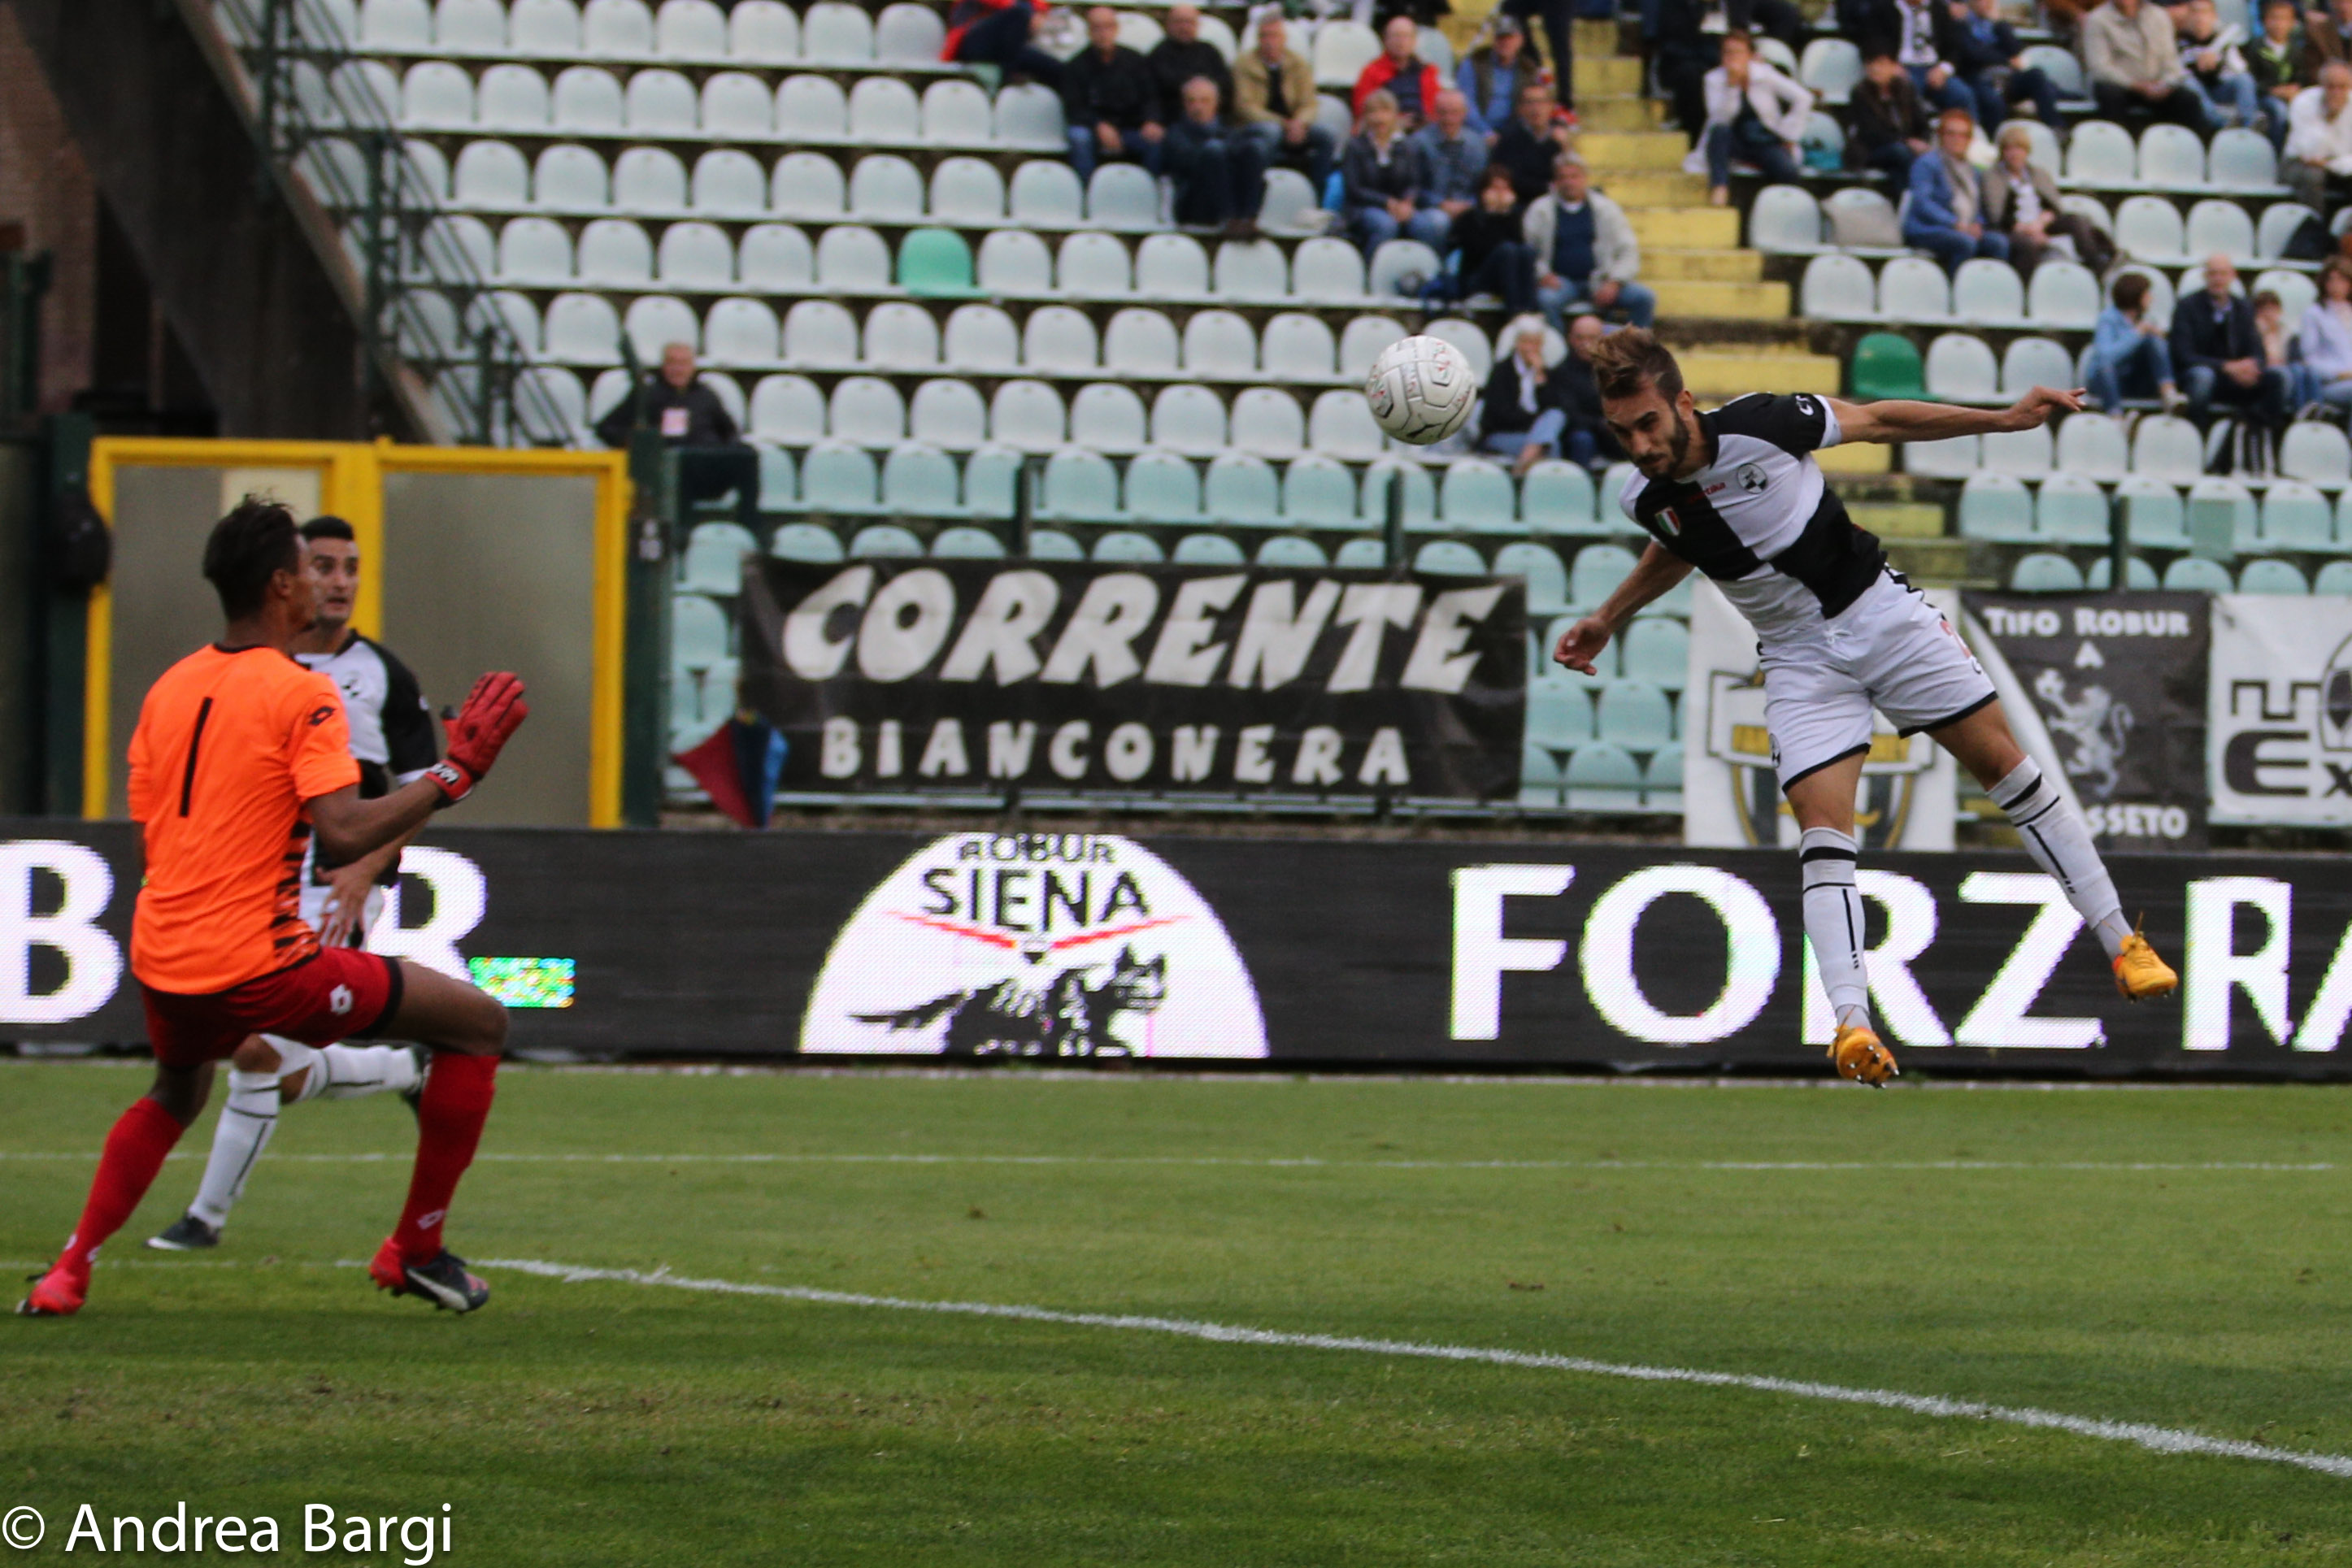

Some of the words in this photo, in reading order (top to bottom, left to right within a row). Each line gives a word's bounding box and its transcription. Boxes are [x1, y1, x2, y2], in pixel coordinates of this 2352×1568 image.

[782, 563, 1502, 693] CORRENTE
[1983, 606, 2061, 636] TIFO
[2074, 606, 2191, 637] ROBUR
[2074, 640, 2105, 669] A
[180, 697, 213, 818] 1
[820, 716, 1410, 786] BIANCONERA
[920, 868, 1150, 932] SIENA
